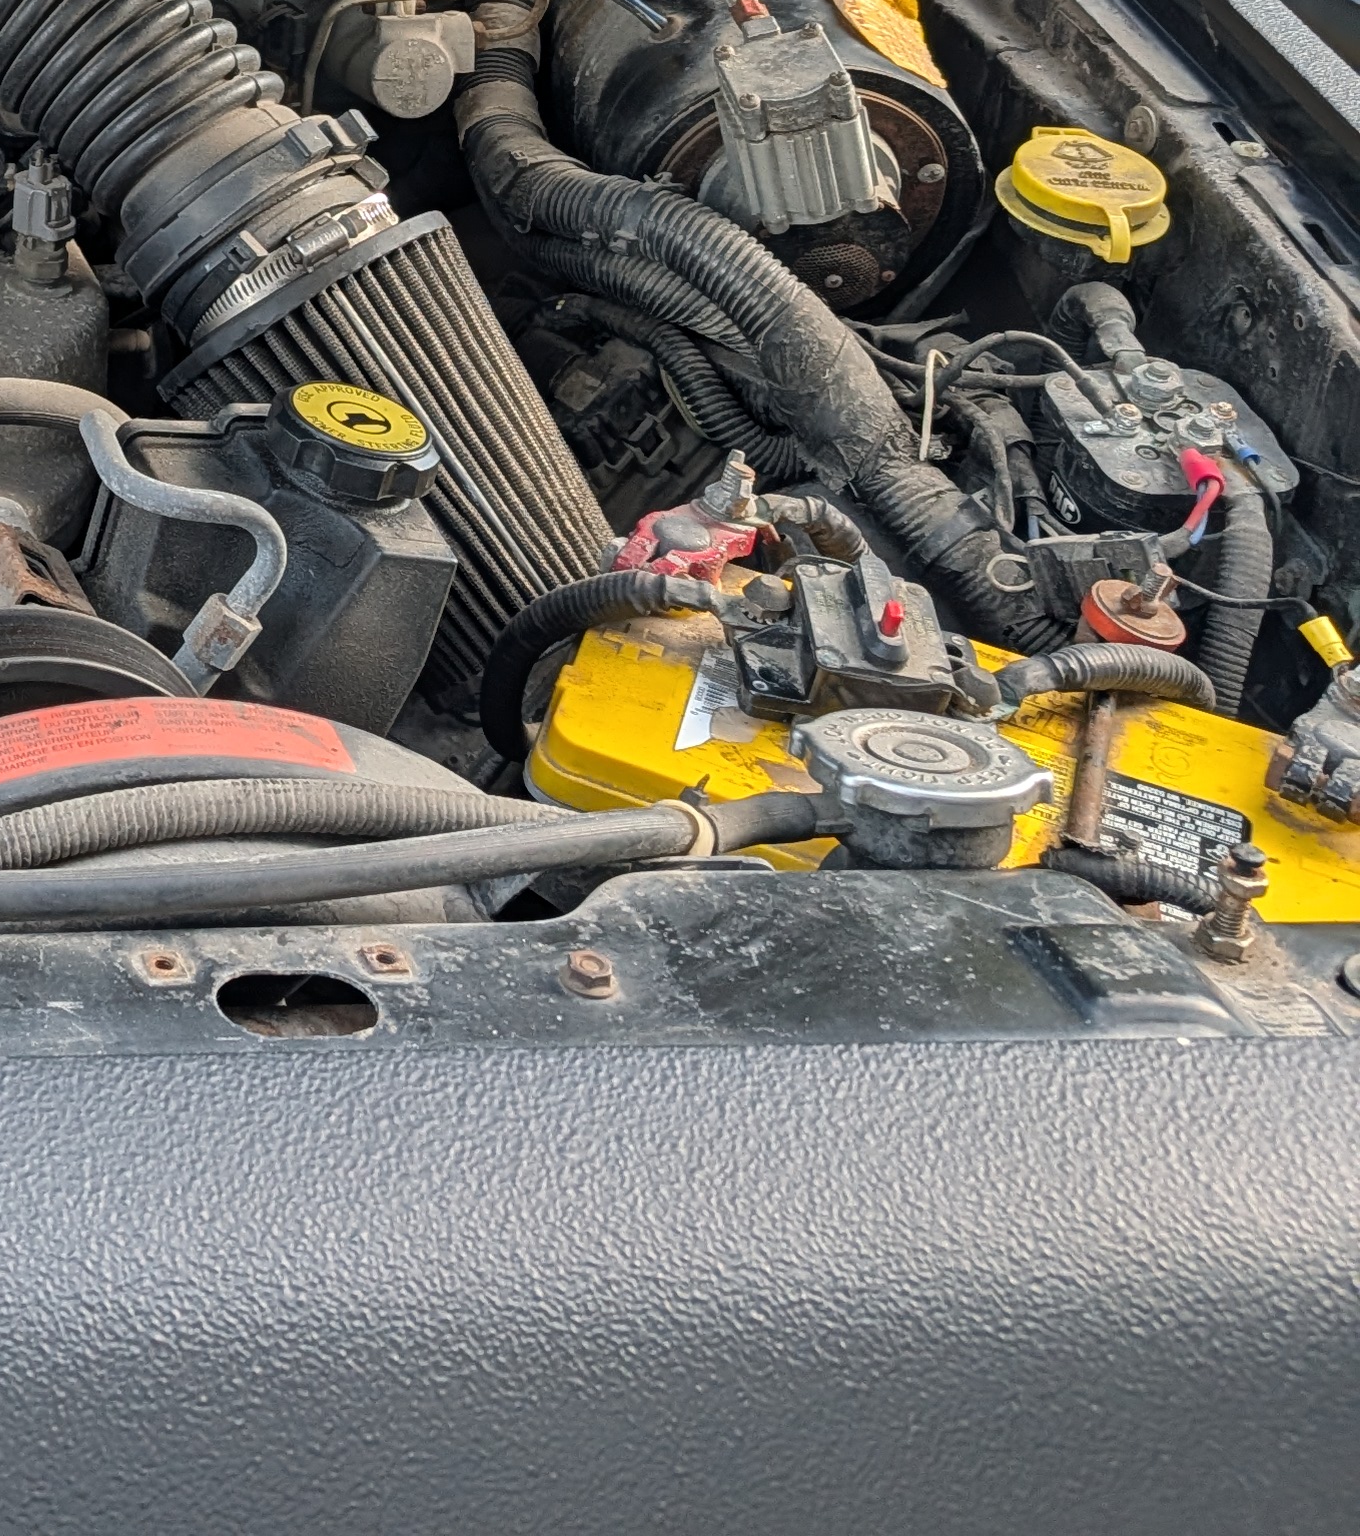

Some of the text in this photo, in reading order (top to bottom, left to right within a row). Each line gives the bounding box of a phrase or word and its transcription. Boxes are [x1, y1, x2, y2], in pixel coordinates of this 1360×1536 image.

[313, 385, 380, 402] APPROVED
[307, 415, 346, 439] POWER
[50, 706, 95, 719] RISQUE
[96, 705, 111, 713] DE
[59, 723, 87, 734] TOUT
[52, 734, 151, 753] EST EN POSITION
[0, 756, 47, 774] MARCHE
[1130, 799, 1155, 811] OPEN
[1162, 799, 1199, 813] OPTIMA
[1132, 806, 1162, 820] REACH
[1158, 808, 1176, 817] NOT
[1164, 817, 1180, 827] THE
[1183, 822, 1195, 831] OF
[1197, 827, 1215, 836] OUT
